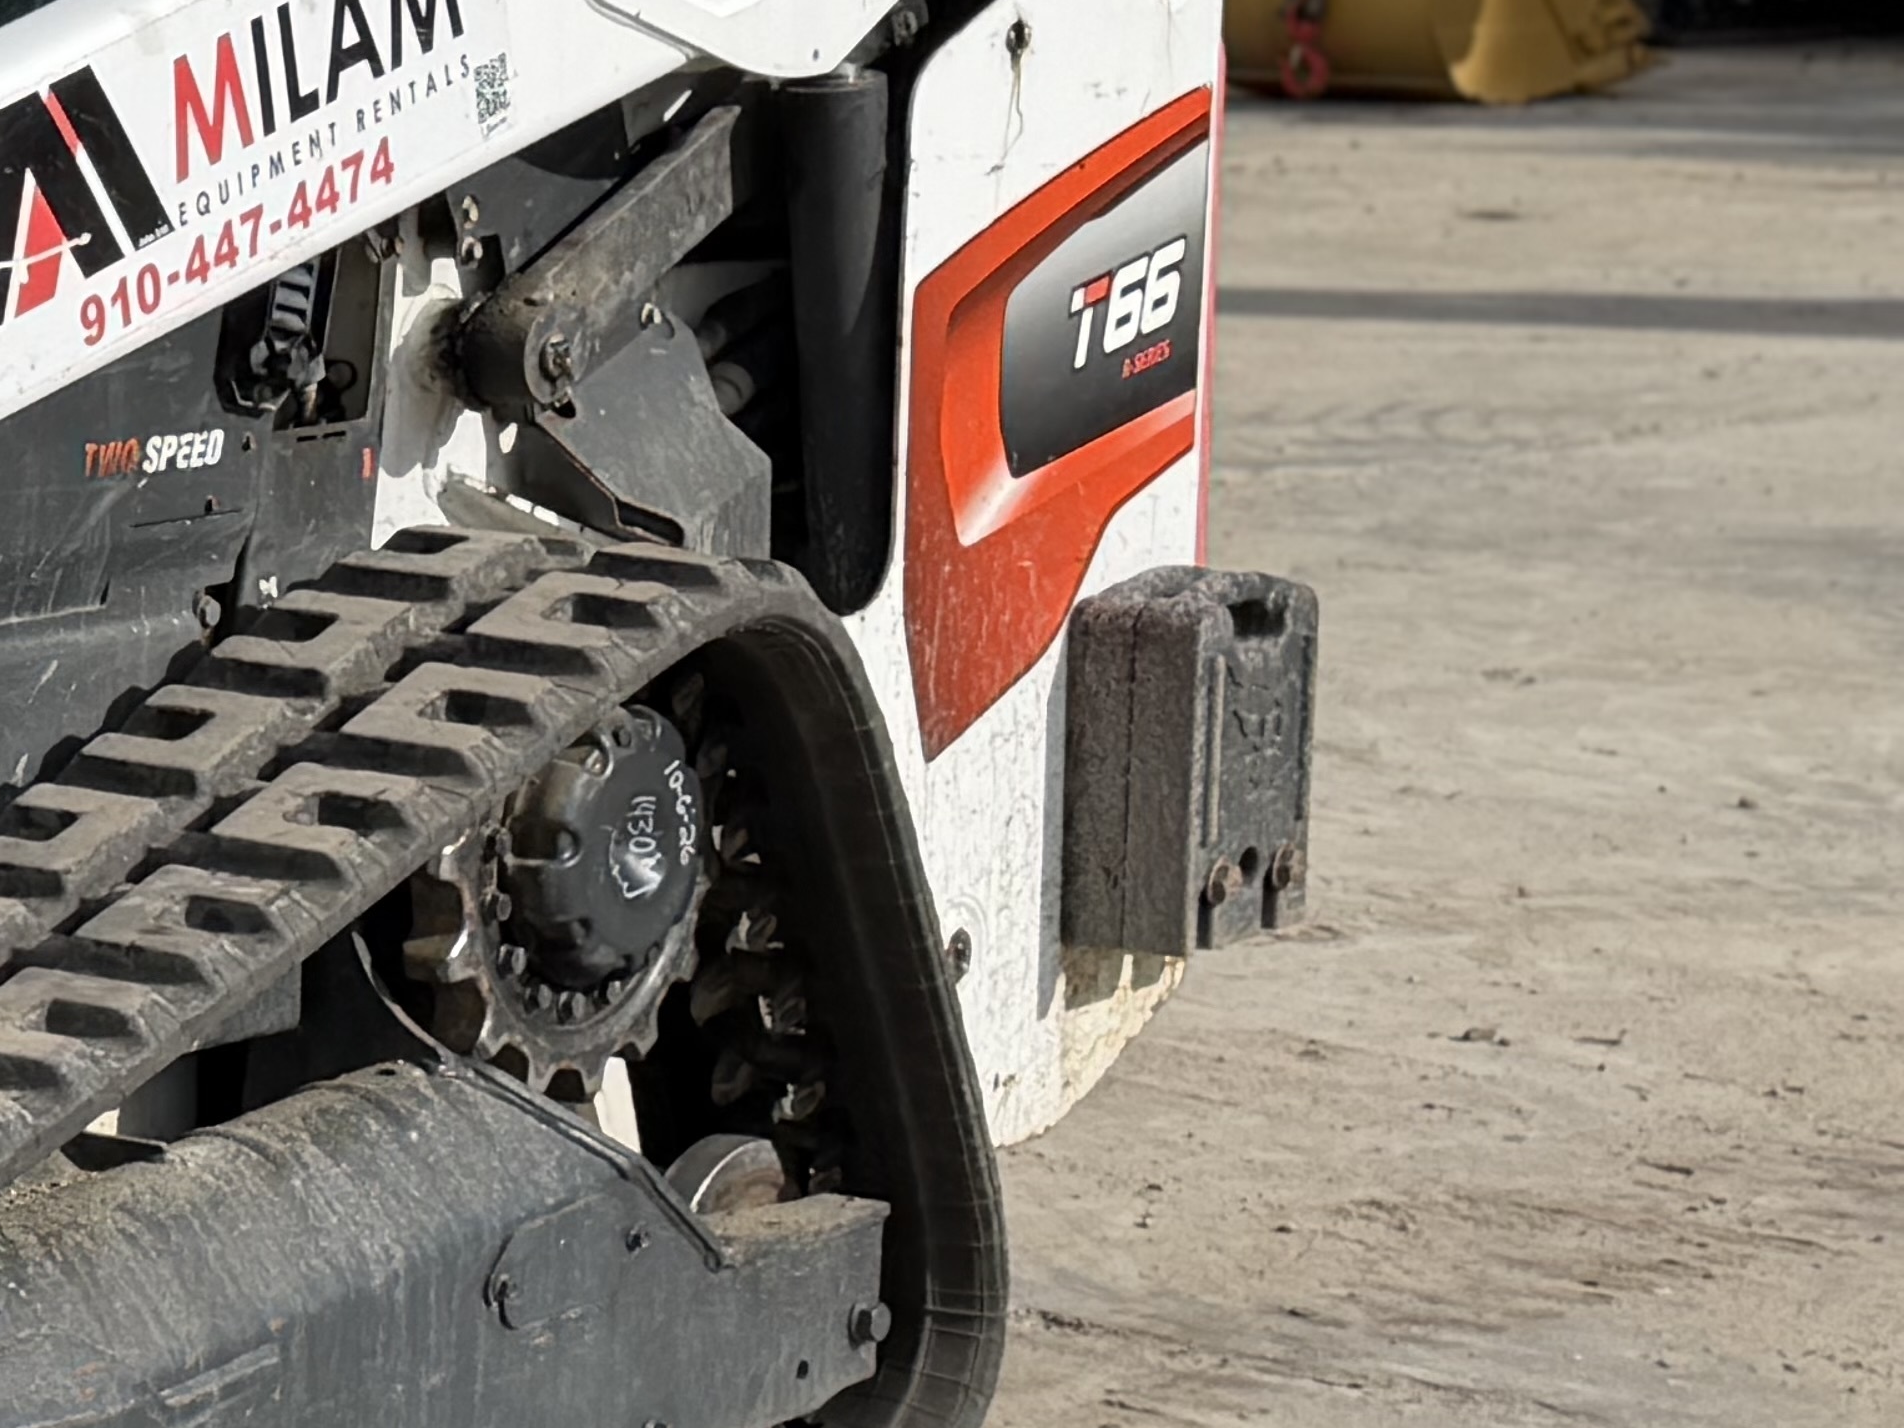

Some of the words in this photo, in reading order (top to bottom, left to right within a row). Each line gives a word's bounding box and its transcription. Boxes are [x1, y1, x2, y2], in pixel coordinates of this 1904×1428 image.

[178, 121, 337, 227] EQUIPMENT
[356, 54, 470, 133] RENTALS
[79, 136, 395, 347] 910-447-4474
[1070, 237, 1186, 370] T66
[85, 438, 141, 478] TWO
[142, 428, 225, 473] SPEED
